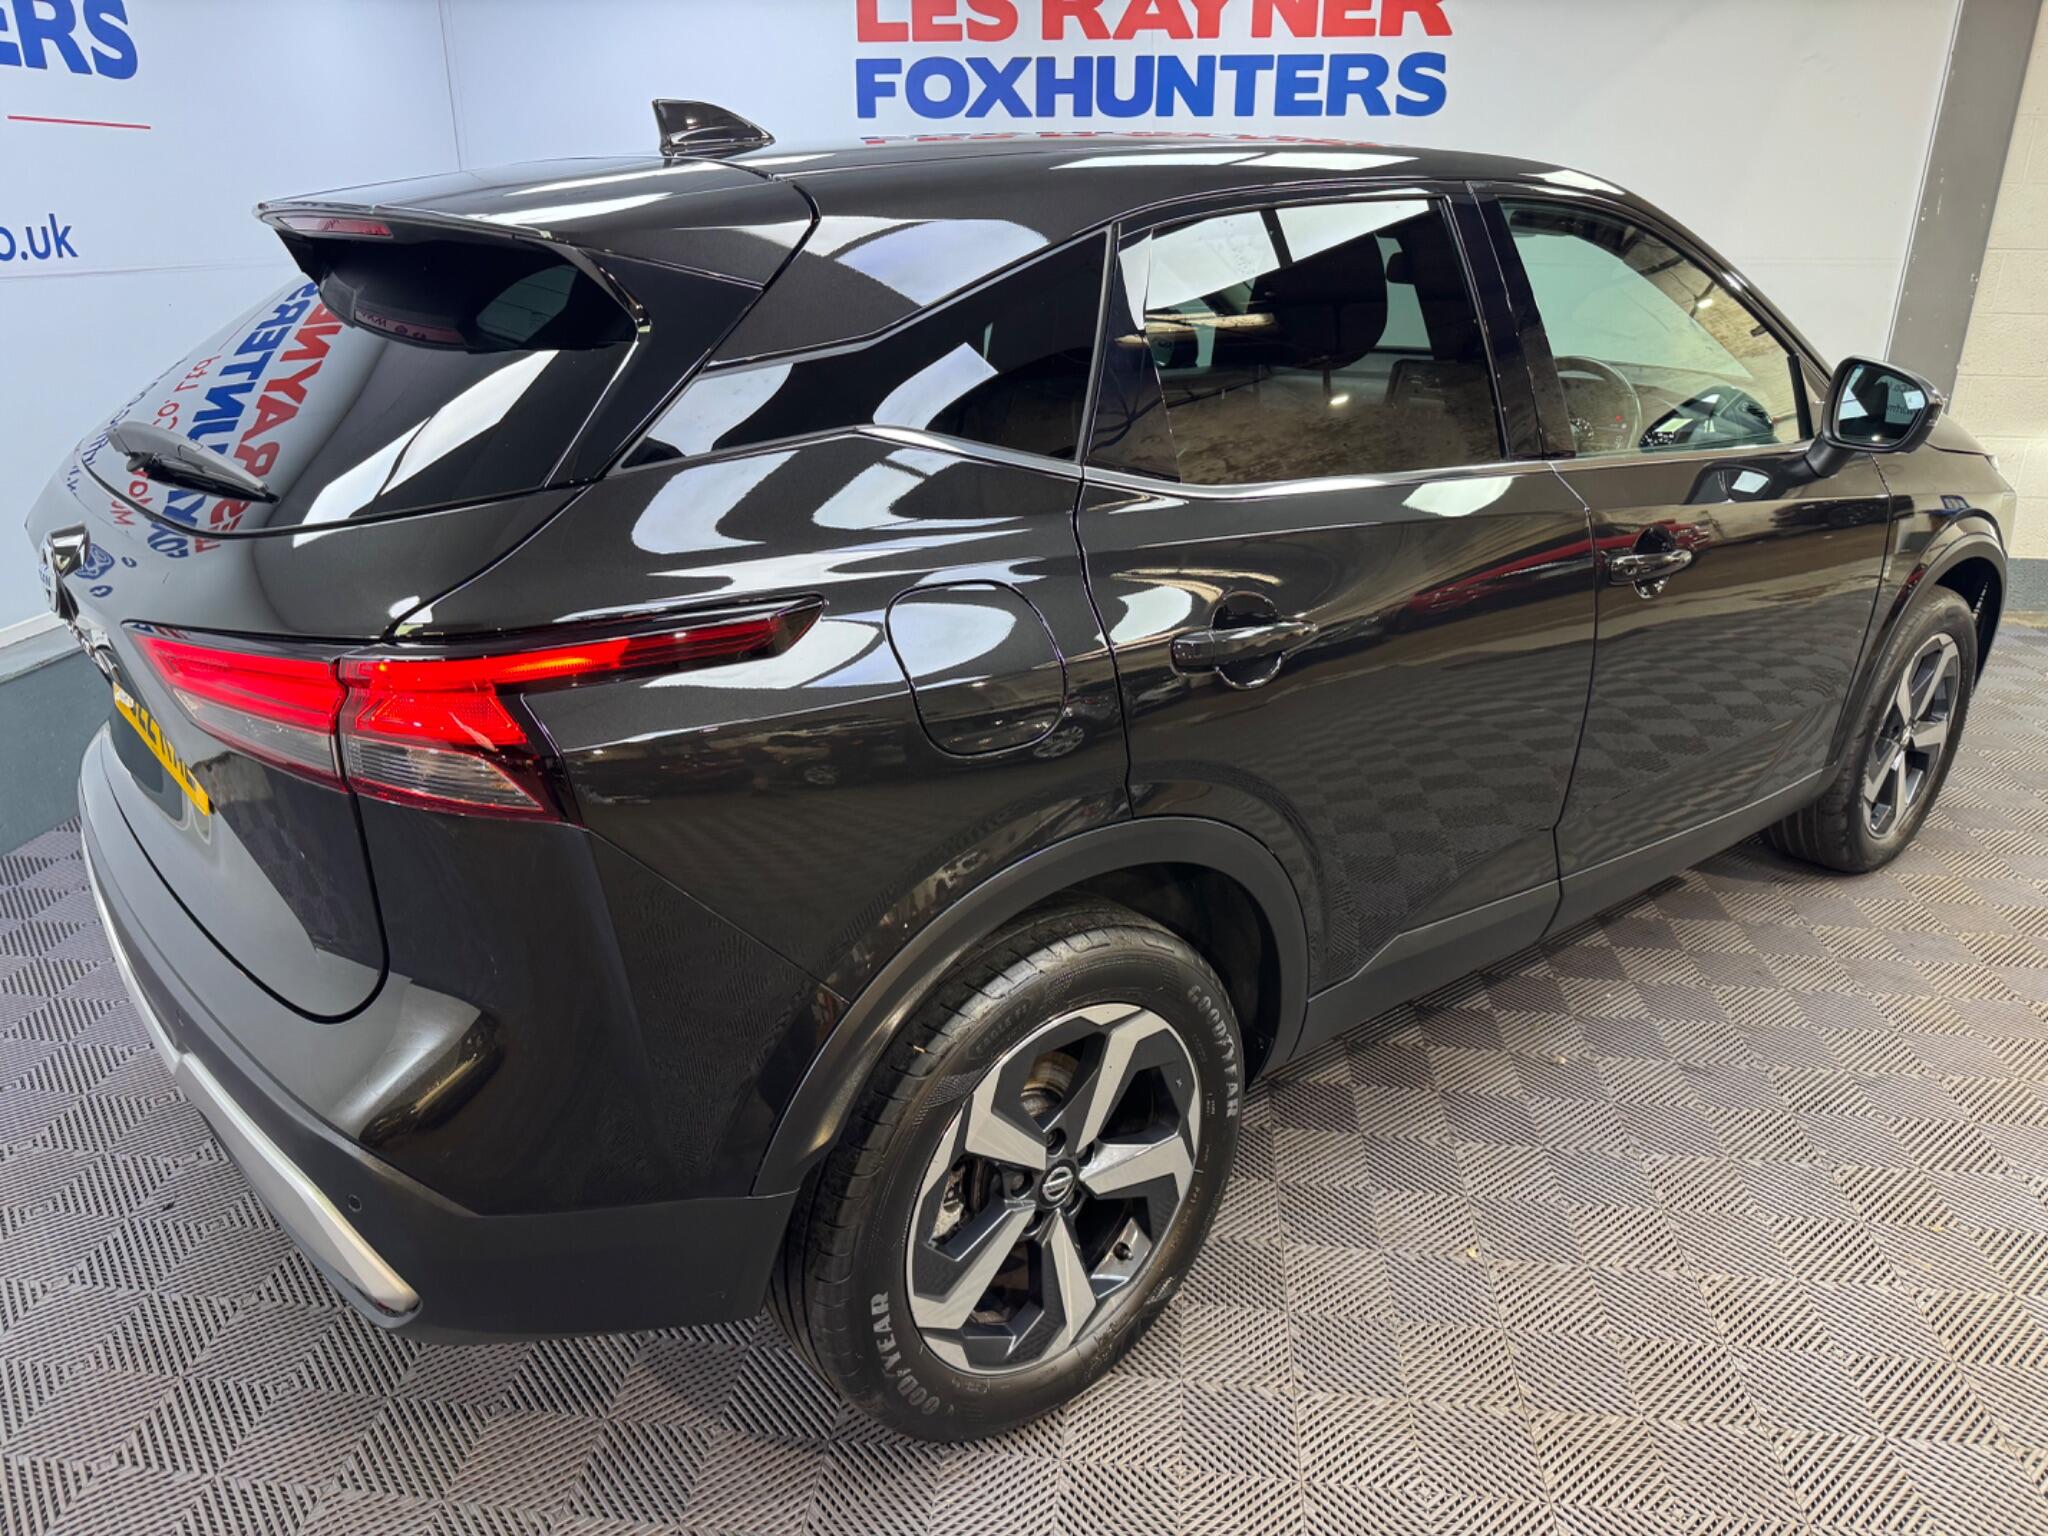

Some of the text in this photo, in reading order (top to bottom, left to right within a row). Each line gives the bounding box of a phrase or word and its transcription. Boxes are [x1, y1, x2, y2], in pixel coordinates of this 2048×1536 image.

[857, 0, 1453, 42] LES RAYNER
[856, 52, 1448, 119] FOXHUNTERS
